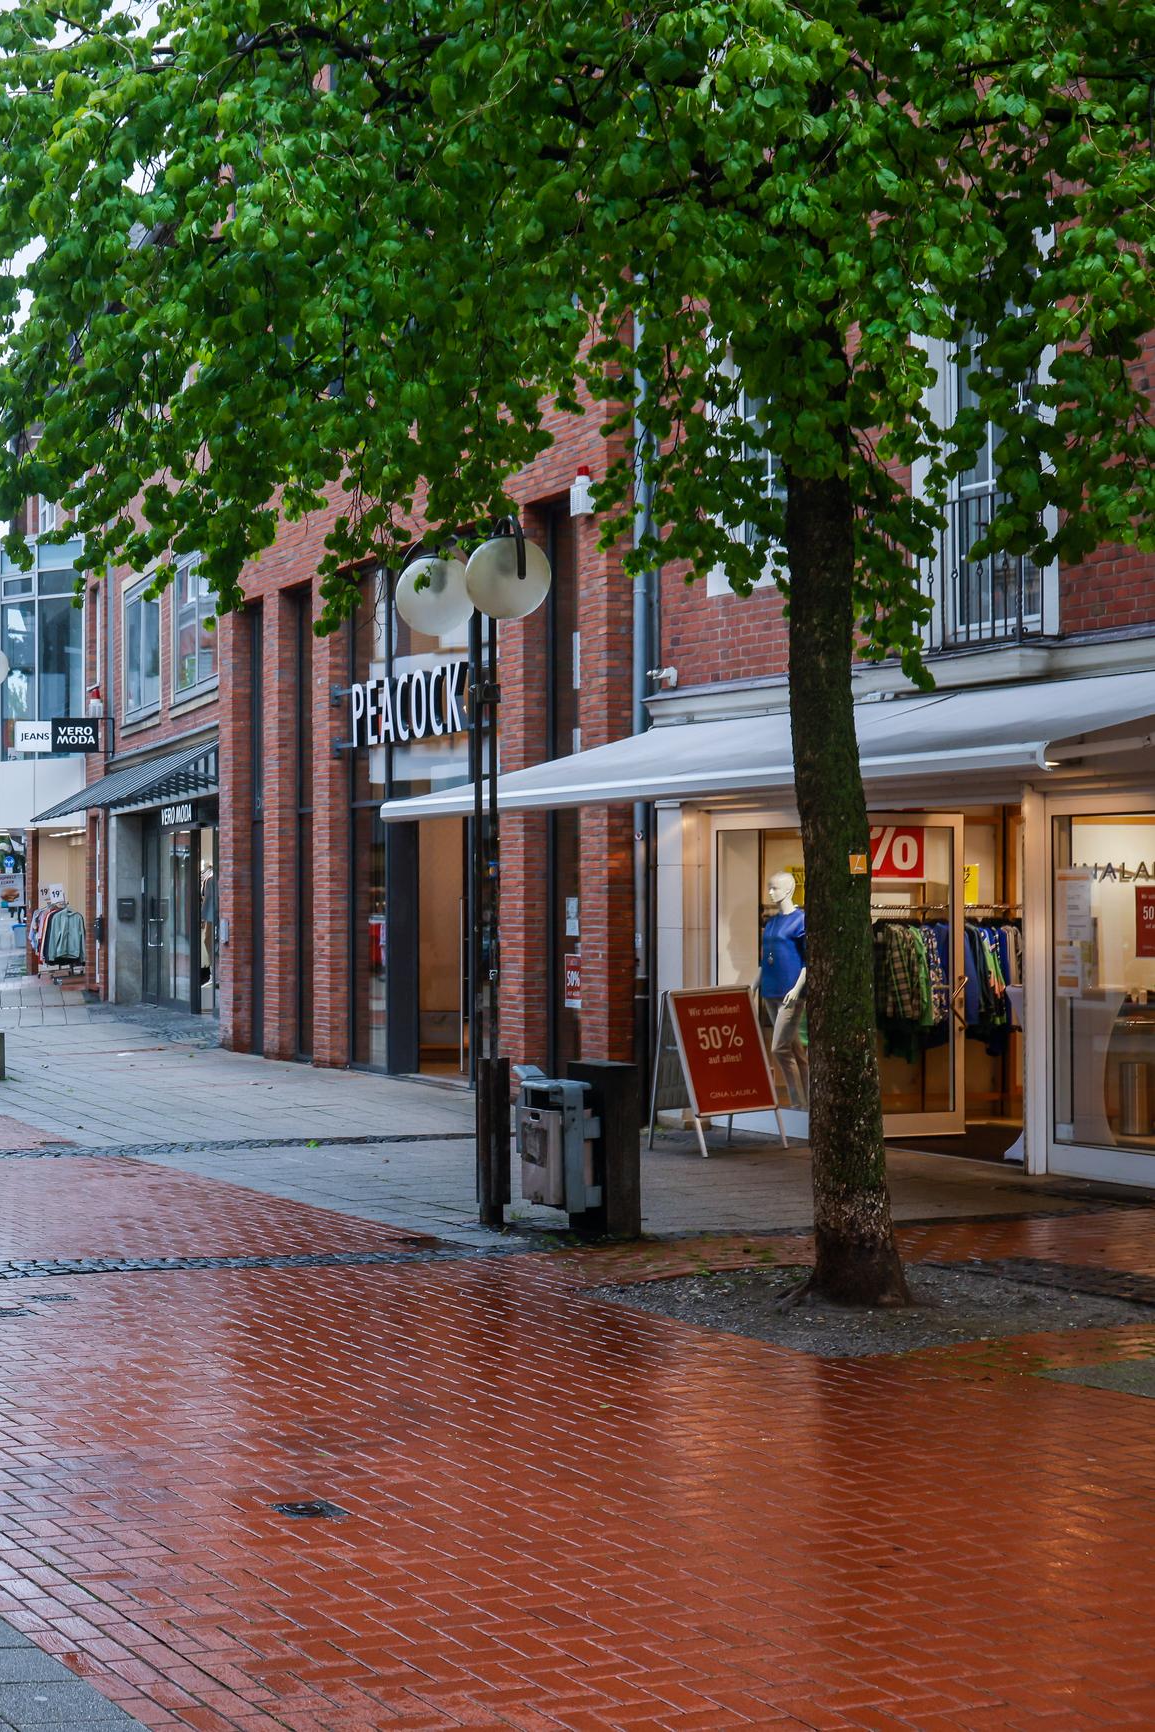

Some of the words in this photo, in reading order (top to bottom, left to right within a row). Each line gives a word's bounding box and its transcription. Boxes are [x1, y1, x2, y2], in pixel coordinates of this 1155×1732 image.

[351, 661, 462, 748] PEACOCK
[20, 732, 50, 742] JEANS
[57, 726, 93, 736] VERO
[56, 736, 96, 745] MODA
[161, 806, 175, 826] VERO
[175, 803, 192, 823] MODA
[688, 1007, 701, 1017] Wir
[702, 1004, 740, 1016] schließen!
[697, 1024, 744, 1050] 50%
[708, 1054, 720, 1065] auf
[722, 1052, 742, 1063] alles!
[709, 1091, 729, 1099] GINA
